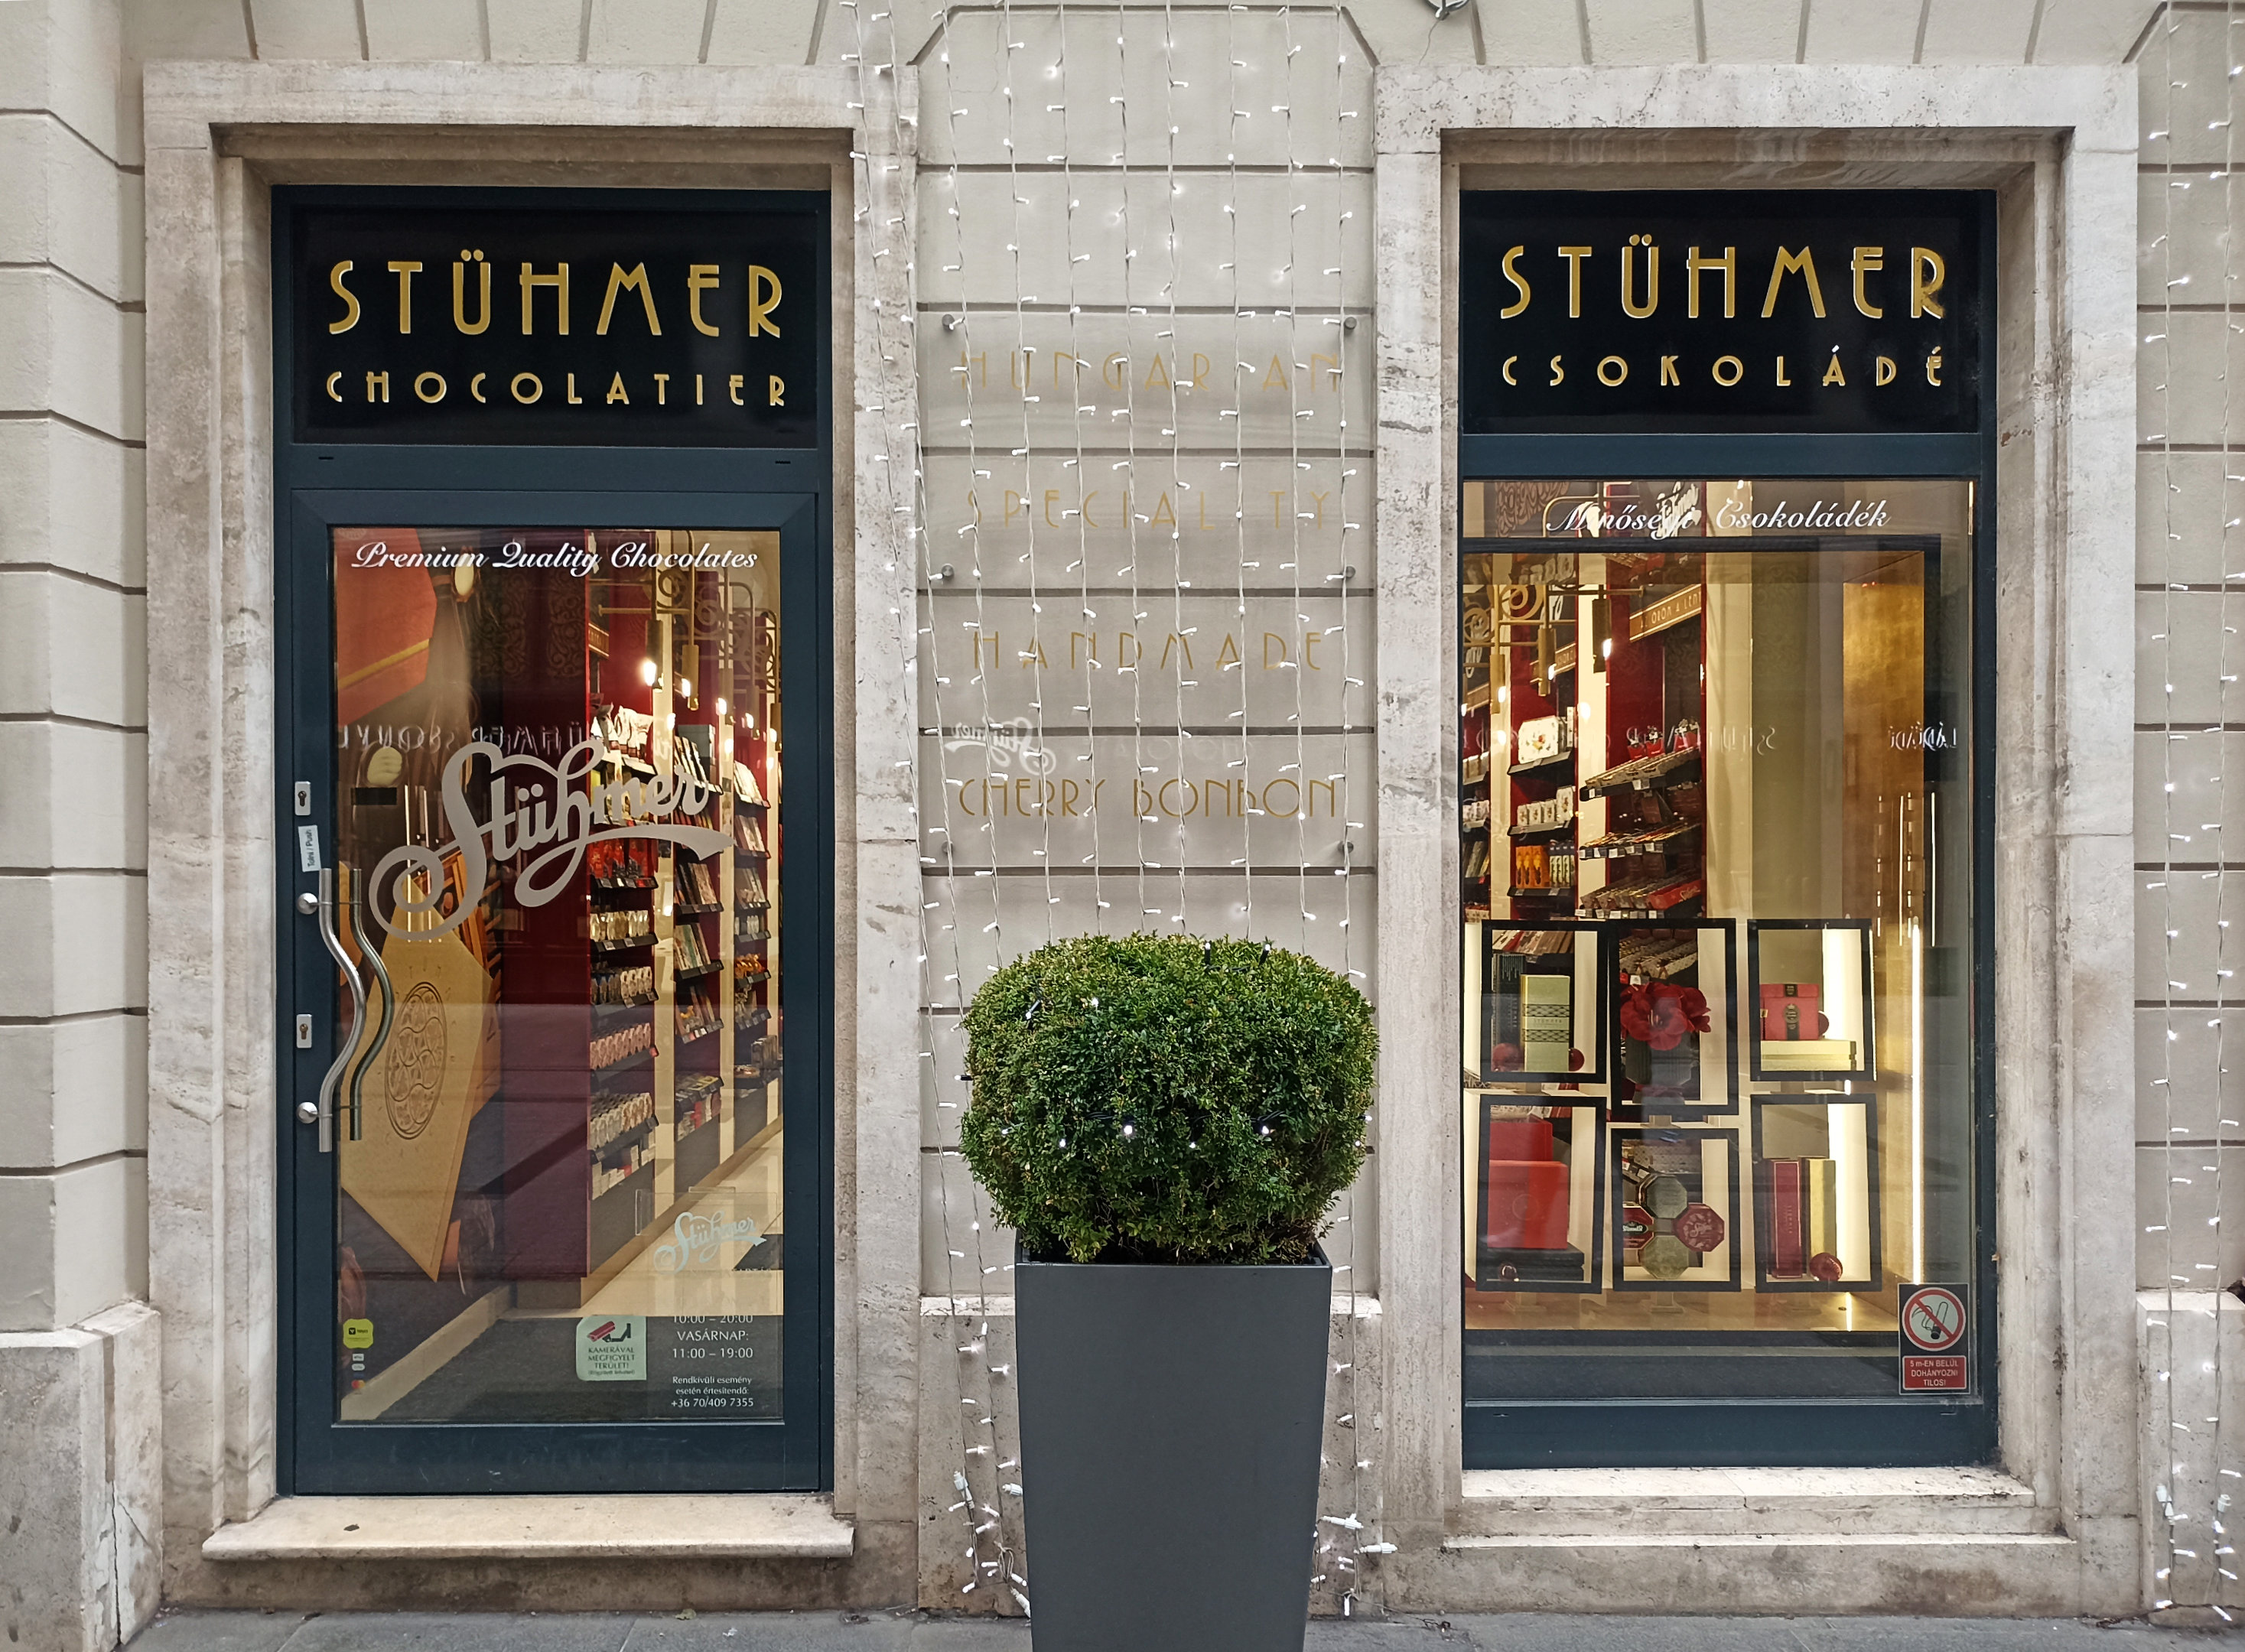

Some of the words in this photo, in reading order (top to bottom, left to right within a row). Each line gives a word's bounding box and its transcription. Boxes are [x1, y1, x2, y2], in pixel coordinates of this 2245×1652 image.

[329, 249, 782, 338] STÜHMER
[1501, 234, 1945, 320] STÜHMER
[961, 351, 1339, 392] HUNGARAN
[1502, 345, 1943, 387] CSOKOLÁDÉ
[327, 371, 785, 406] CHOCOLATIER
[968, 489, 1330, 531] SPECIALTY
[1716, 499, 1892, 530] Csokoládék
[351, 541, 490, 569] Premium
[492, 541, 603, 577] Quality
[610, 541, 758, 569] Chocolates
[974, 631, 1322, 671] HANDMADE
[959, 779, 1106, 818] CHERRY
[1134, 779, 1336, 818] BONBON
[369, 740, 737, 941] Stühmer
[654, 1211, 767, 1274] Stühmer
[673, 1315, 704, 1324] 10:00
[720, 1315, 753, 1324] 20:00
[677, 1328, 749, 1341] VASÁRNAP:
[673, 1348, 705, 1358] 11:00
[720, 1348, 753, 1358] 19:00
[672, 1376, 715, 1384] Rendkívüli
[717, 1376, 752, 1385] esemény
[1911, 1368, 1958, 1377] DOHÁNYOZNI
[672, 1398, 690, 1407] +36
[693, 1396, 726, 1408] 70/409
[730, 1397, 753, 1407] 7355
[675, 1387, 701, 1395] esetén
[703, 1387, 749, 1395] értesítendő:
